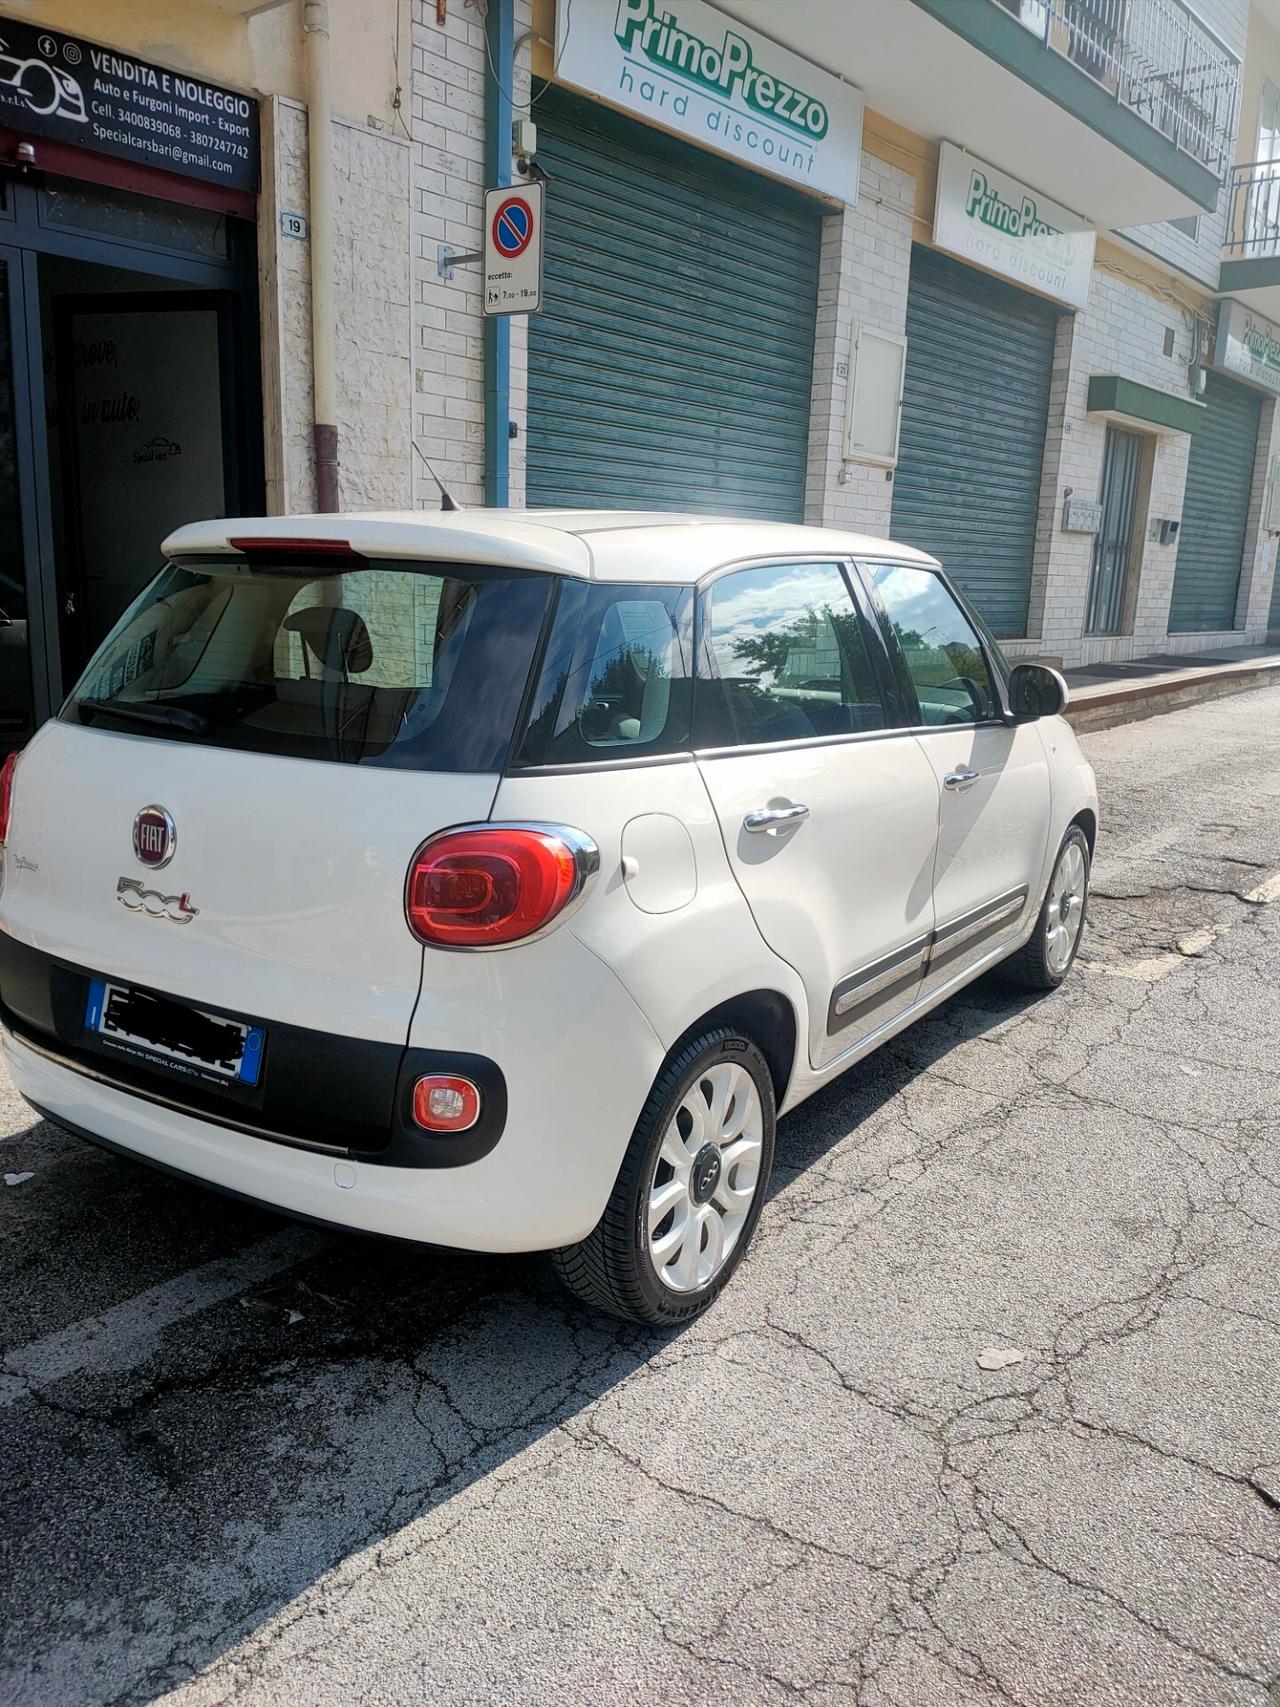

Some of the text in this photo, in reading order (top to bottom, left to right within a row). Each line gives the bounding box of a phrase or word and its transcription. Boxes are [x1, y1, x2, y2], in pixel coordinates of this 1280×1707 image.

[90, 49, 250, 119] VENDITA E NOLEGGIO
[614, 0, 829, 141] PrimoPrezzo
[91, 100, 115, 120] Cell.
[117, 107, 182, 139] 3400839068
[190, 130, 249, 160] 3807247742
[93, 78, 121, 98] Auto
[123, 90, 130, 101] e
[132, 89, 173, 114] Furgoni
[174, 104, 210, 126] Import
[218, 119, 250, 138] Export
[619, 66, 815, 174] hard discount
[92, 122, 233, 175] Specialcarsbari@gmail.com
[288, 219, 301, 233] 19
[966, 169, 1076, 266] PrimoPreo
[487, 272, 513, 281] eccetto:
[1009, 252, 1067, 290] discount
[141, 823, 165, 853] FIAT
[144, 1053, 187, 1073] SPECIAL CARS
